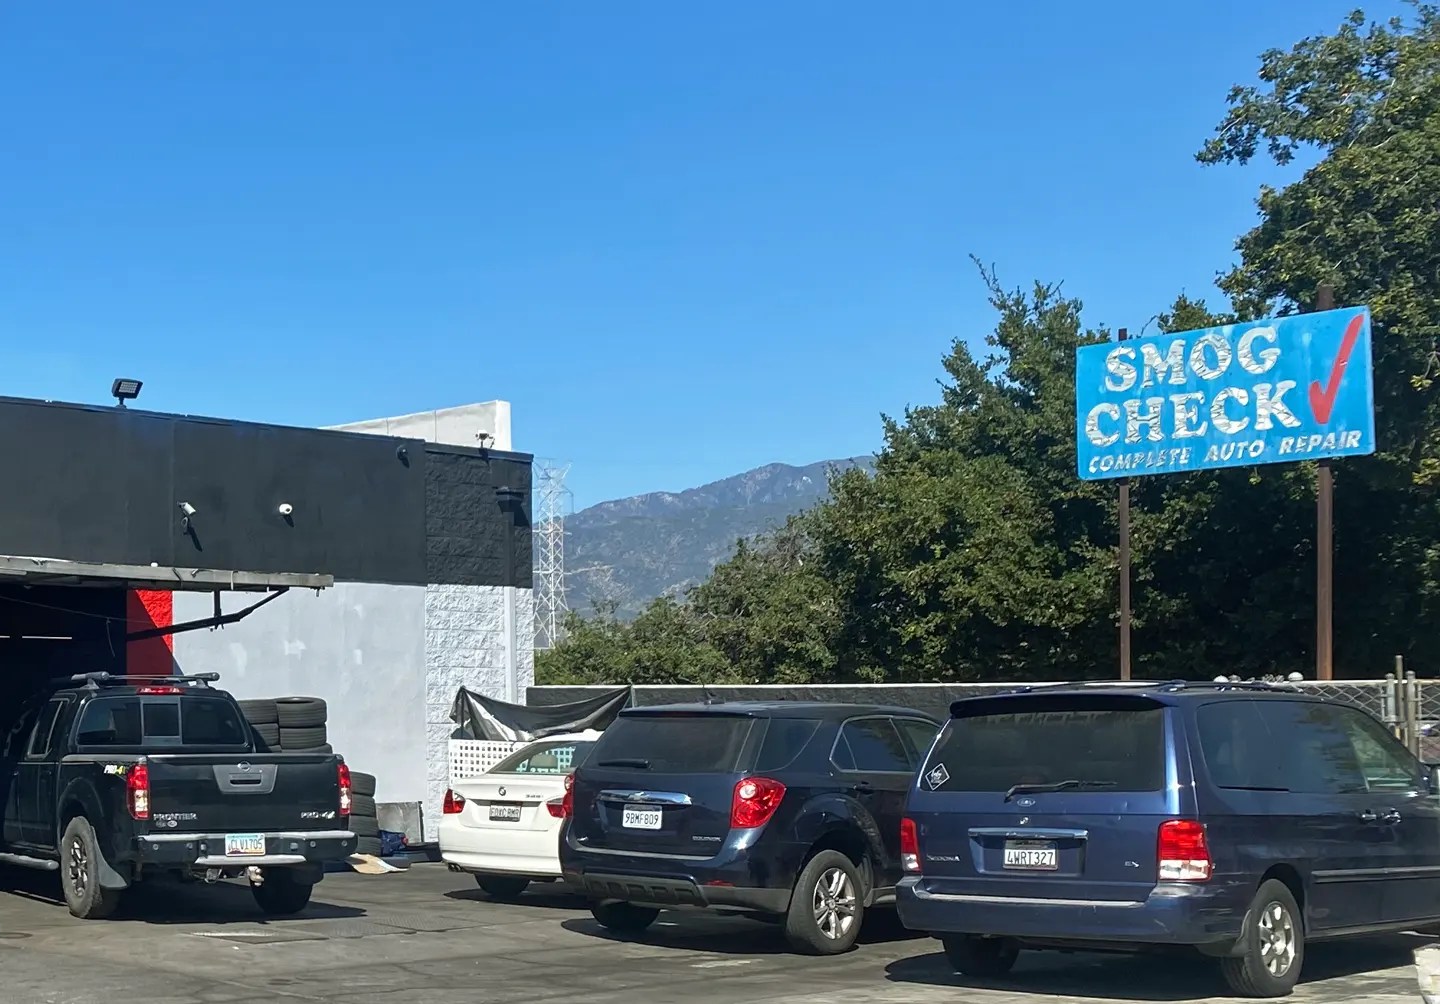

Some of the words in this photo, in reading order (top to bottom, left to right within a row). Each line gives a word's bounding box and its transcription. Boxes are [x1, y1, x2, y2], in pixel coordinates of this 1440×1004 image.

[1105, 326, 1281, 392] SMOG
[1085, 379, 1302, 447] CHECK
[1088, 446, 1192, 474] COMPLETE
[1204, 439, 1265, 463] AUTO
[1279, 430, 1362, 454] REPAIR
[625, 812, 659, 826] 9BMF809
[1007, 850, 1054, 866] 4WRT327
